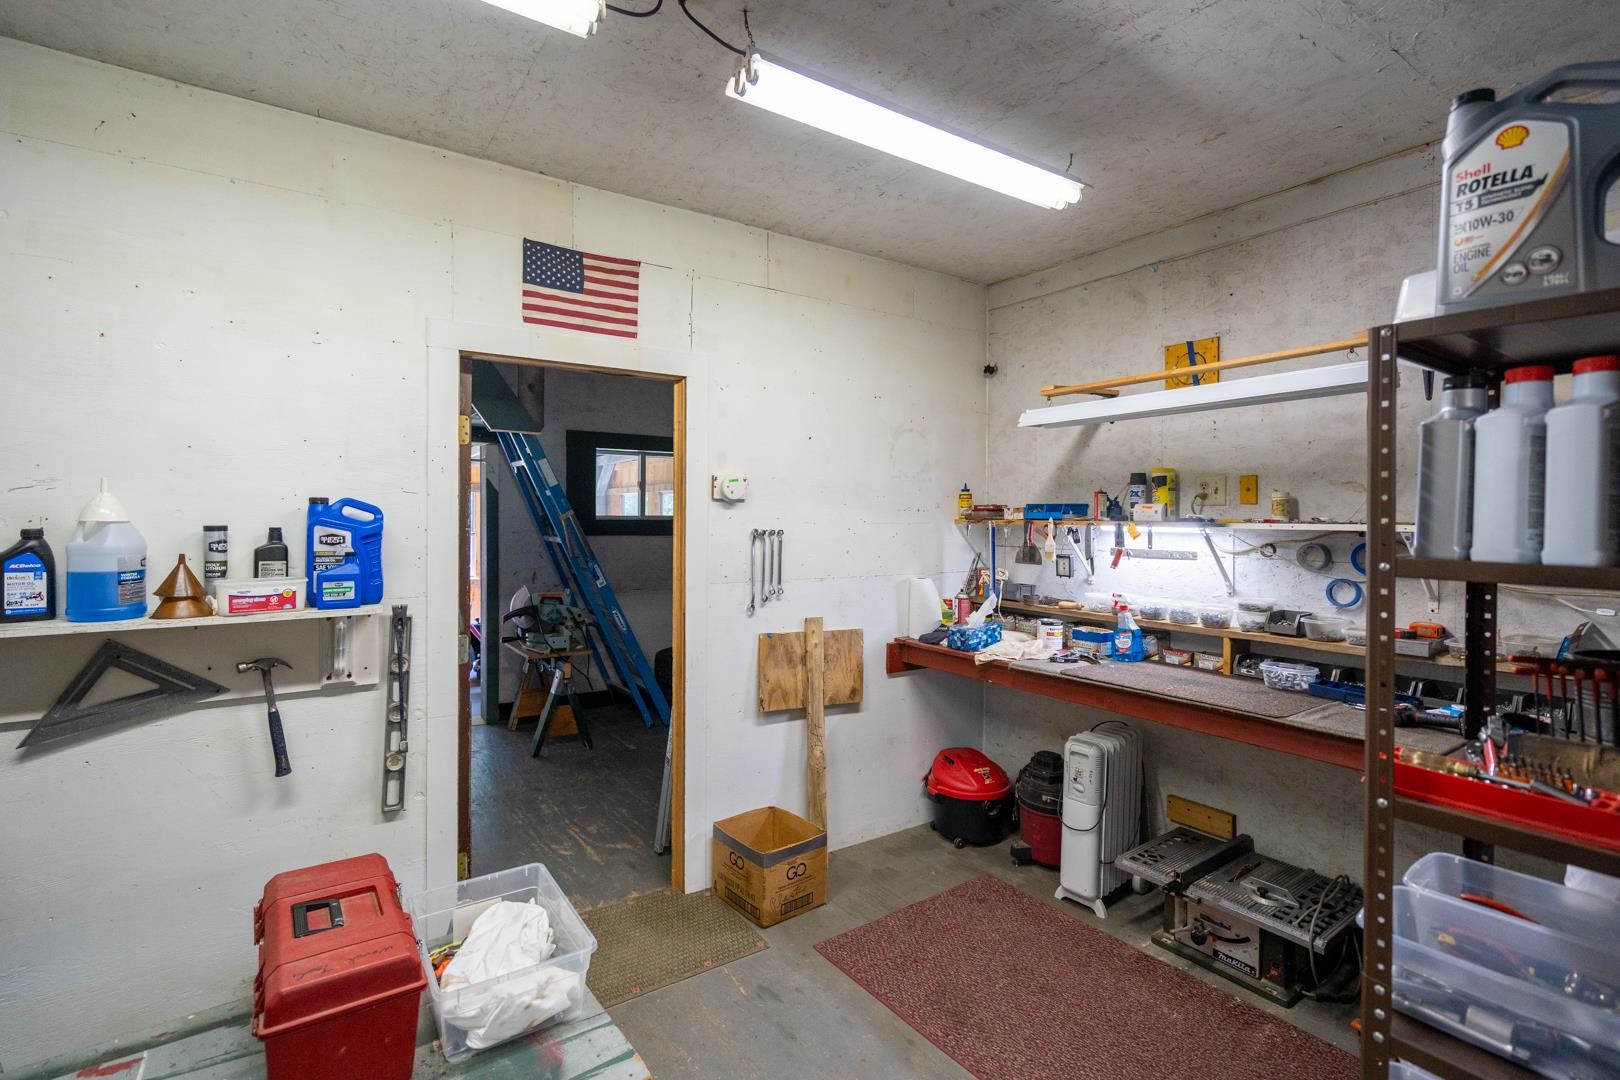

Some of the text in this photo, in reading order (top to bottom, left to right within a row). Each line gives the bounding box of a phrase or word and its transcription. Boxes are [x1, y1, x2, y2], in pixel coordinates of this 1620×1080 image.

[1456, 163, 1492, 181] Shell
[1456, 165, 1534, 198] ROTELLA
[1455, 199, 1474, 212] T5
[1466, 210, 1514, 231] 10W-30
[1453, 247, 1491, 265] ENGINE
[1453, 262, 1470, 274] OIL
[729, 851, 745, 870] GO
[786, 862, 807, 881] GO
